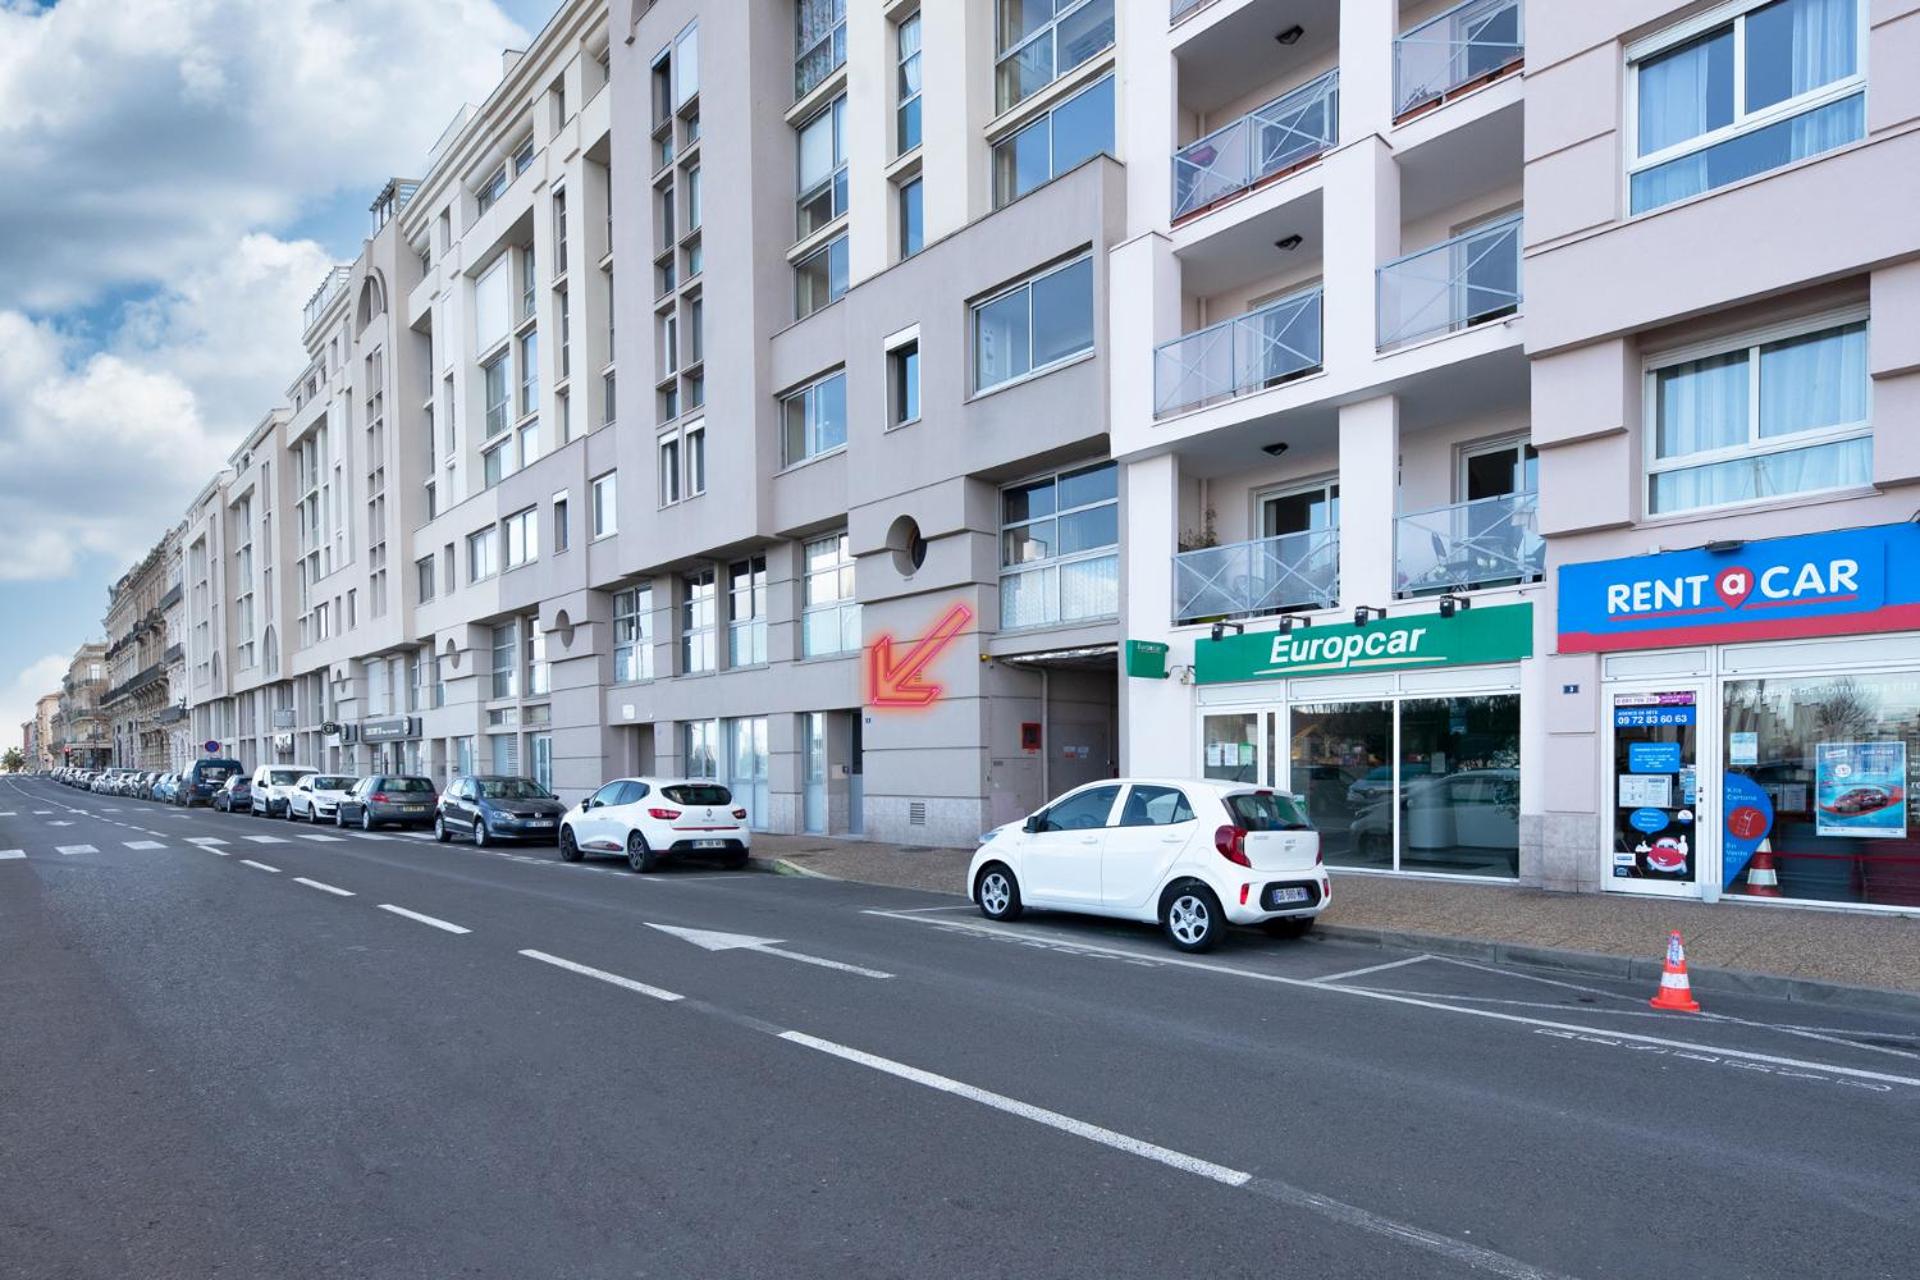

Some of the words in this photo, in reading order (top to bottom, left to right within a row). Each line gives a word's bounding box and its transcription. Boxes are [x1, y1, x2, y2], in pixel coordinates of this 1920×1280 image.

[1607, 575, 1709, 614] RENT
[1721, 573, 1746, 596] a
[1760, 559, 1859, 599] CAR
[1270, 627, 1427, 668] Europcar
[1617, 716, 1630, 725] 09
[1631, 716, 1644, 724] 72
[1646, 715, 1658, 724] 83
[1660, 715, 1673, 724] 60
[1675, 714, 1688, 723] 63
